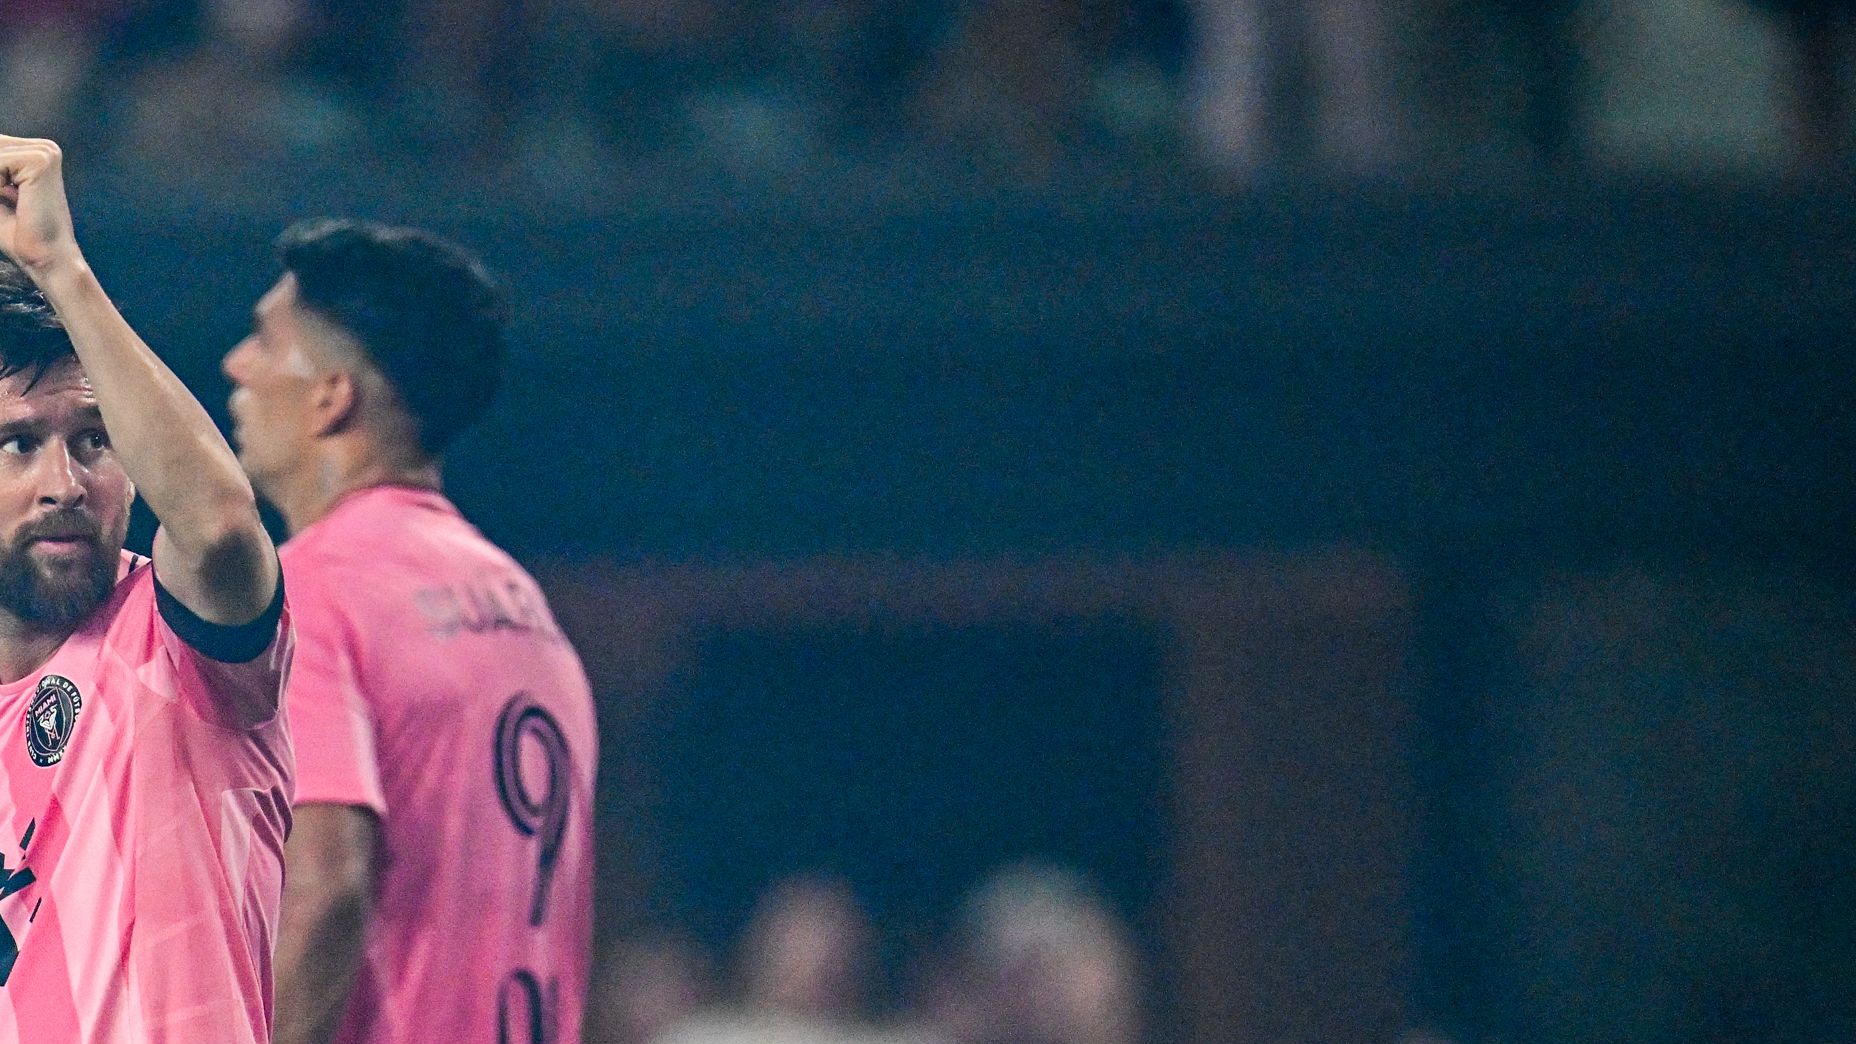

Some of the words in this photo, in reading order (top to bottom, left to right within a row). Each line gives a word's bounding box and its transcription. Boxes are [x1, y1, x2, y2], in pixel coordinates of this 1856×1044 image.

[62, 682, 73, 692] DE
[34, 694, 57, 718] MIAMI
[493, 691, 572, 928] 9
